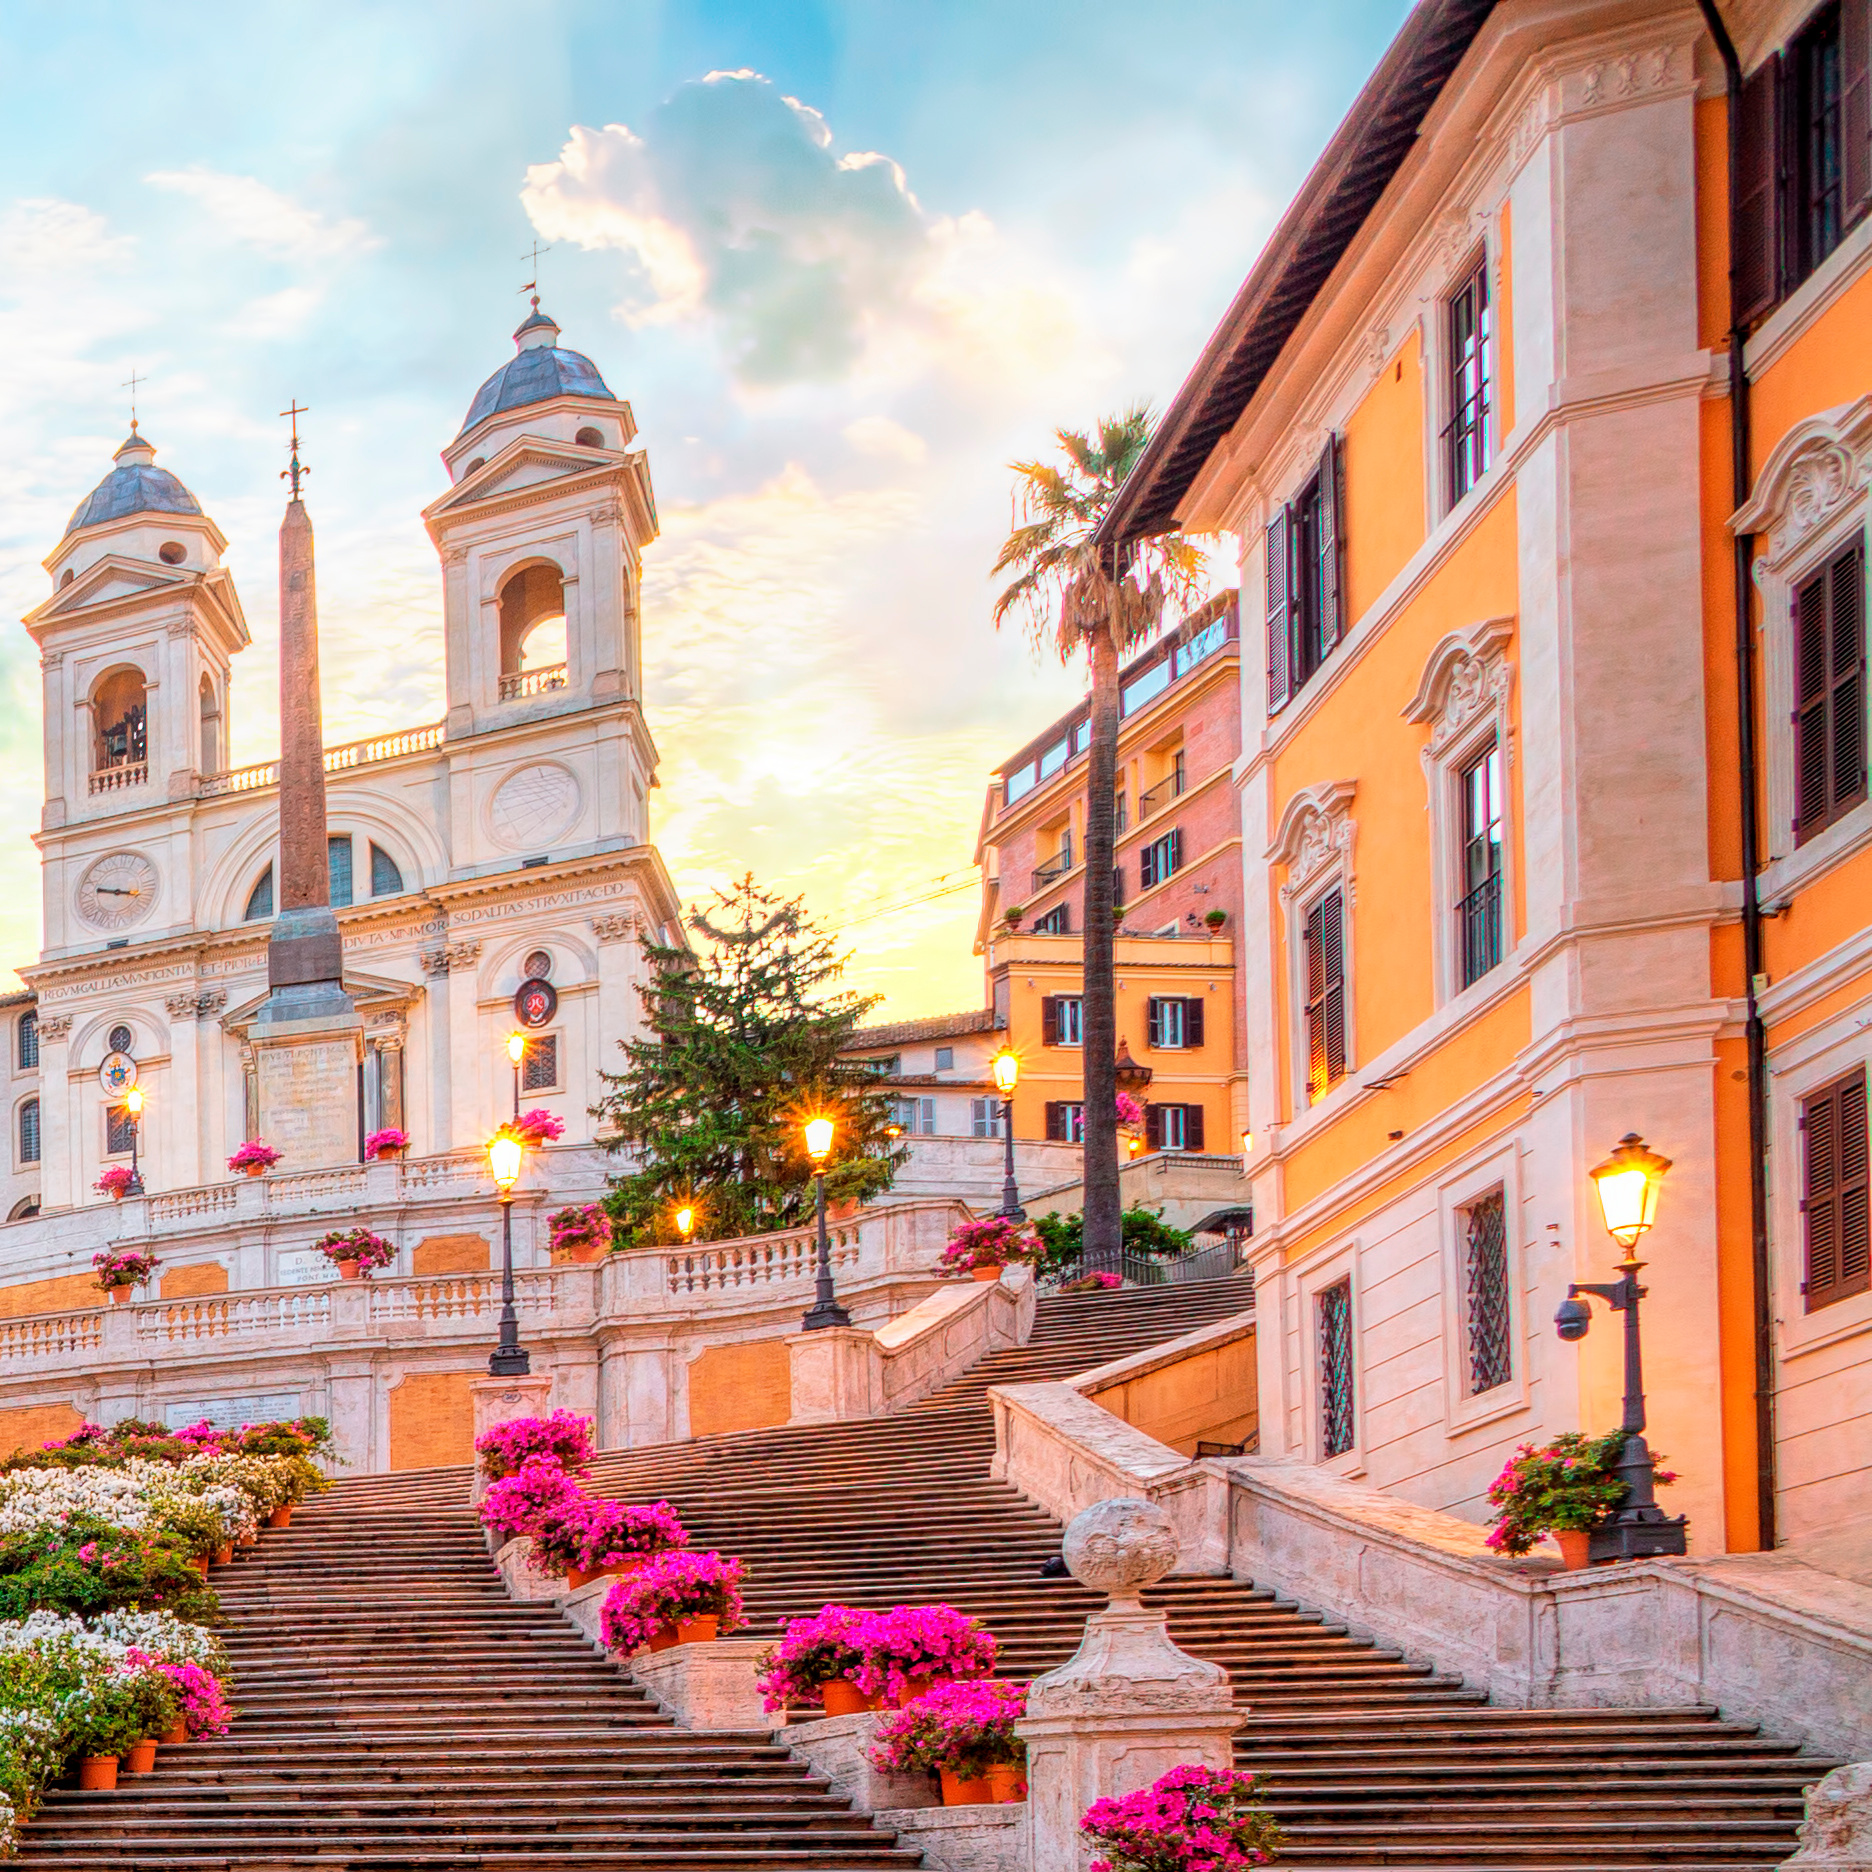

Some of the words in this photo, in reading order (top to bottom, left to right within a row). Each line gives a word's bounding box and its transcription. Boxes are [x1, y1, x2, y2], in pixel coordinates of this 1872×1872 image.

[44, 985, 79, 1001] REGVM
[201, 963, 216, 976] ET
[453, 901, 524, 924] SODALITAS
[527, 889, 583, 910] STRVXIT
